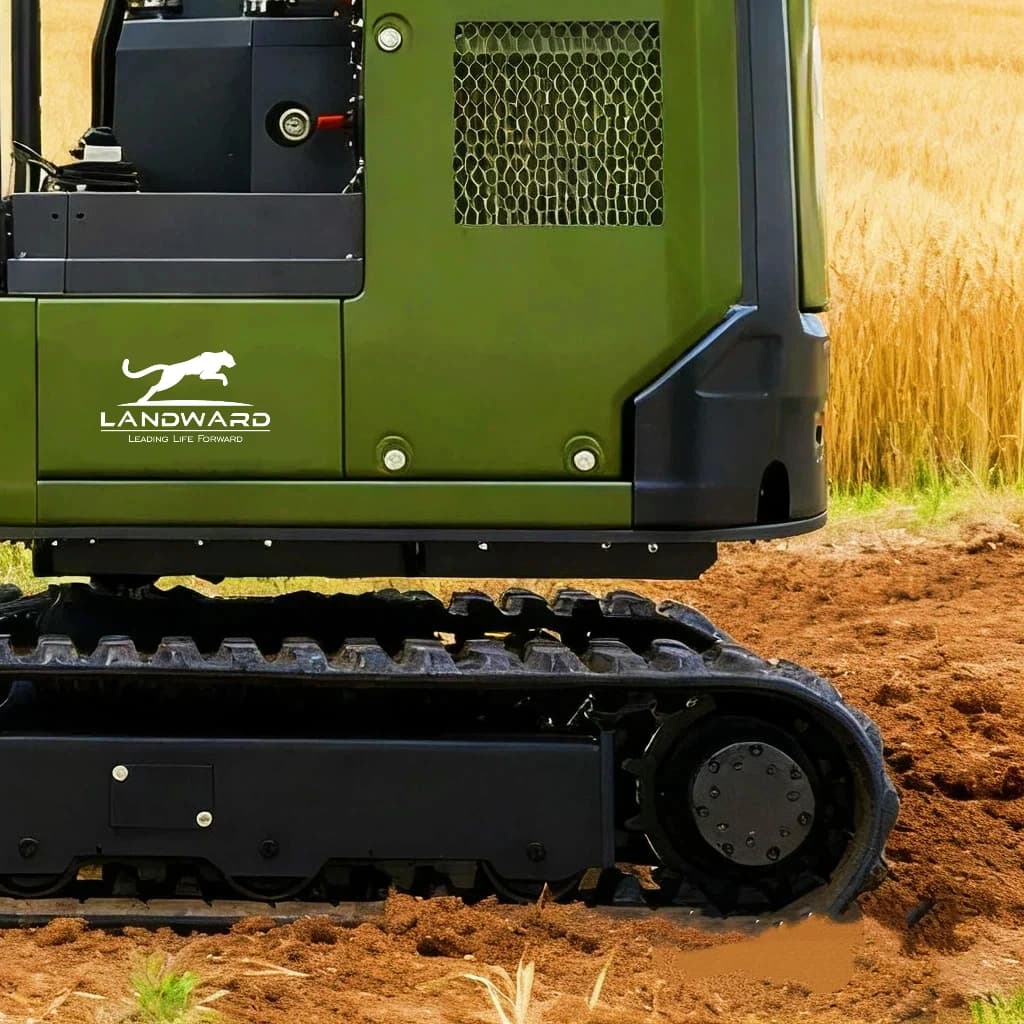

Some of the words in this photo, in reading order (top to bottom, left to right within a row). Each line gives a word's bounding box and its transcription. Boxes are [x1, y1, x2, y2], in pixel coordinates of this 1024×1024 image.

[100, 410, 271, 427] LANDWARD
[128, 434, 169, 443] LEADING
[173, 434, 194, 443] LIFE
[197, 434, 244, 443] FORWARD
